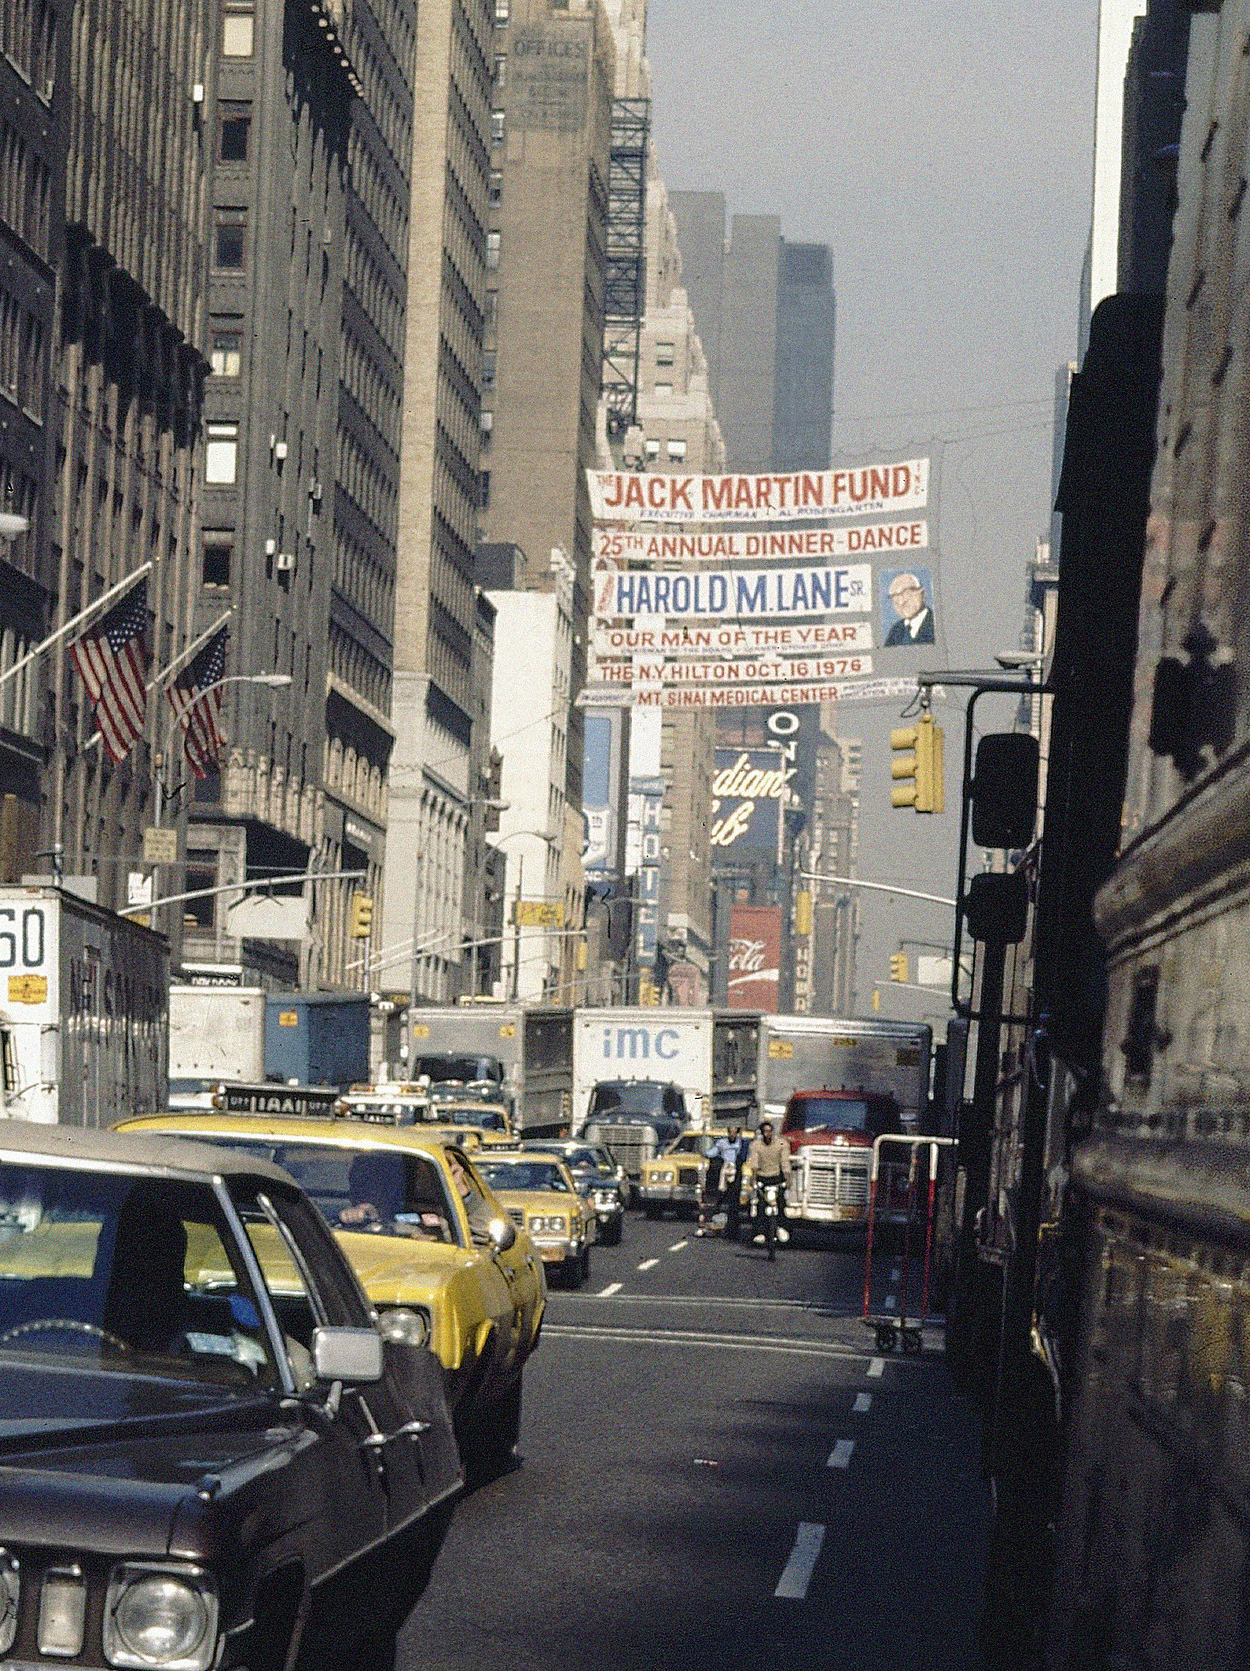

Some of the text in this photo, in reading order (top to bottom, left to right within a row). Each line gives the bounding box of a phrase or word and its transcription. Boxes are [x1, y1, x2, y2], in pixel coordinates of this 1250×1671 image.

[604, 464, 911, 511] JACK MARTIN FUND
[701, 509, 758, 520] CHAIRMAN
[646, 535, 740, 557] ANNUAL
[616, 574, 728, 614] HAROLD
[661, 631, 711, 646] MAN
[717, 631, 746, 647] OF
[750, 629, 792, 645] THE
[600, 664, 634, 681] THE
[670, 663, 740, 681] HILTON
[790, 661, 809, 677] 16
[815, 659, 863, 676] 1976
[667, 690, 707, 705] SINAI
[709, 689, 777, 705] MEDICAL
[780, 686, 839, 703] CENTER
[602, 1025, 681, 1061] imc
